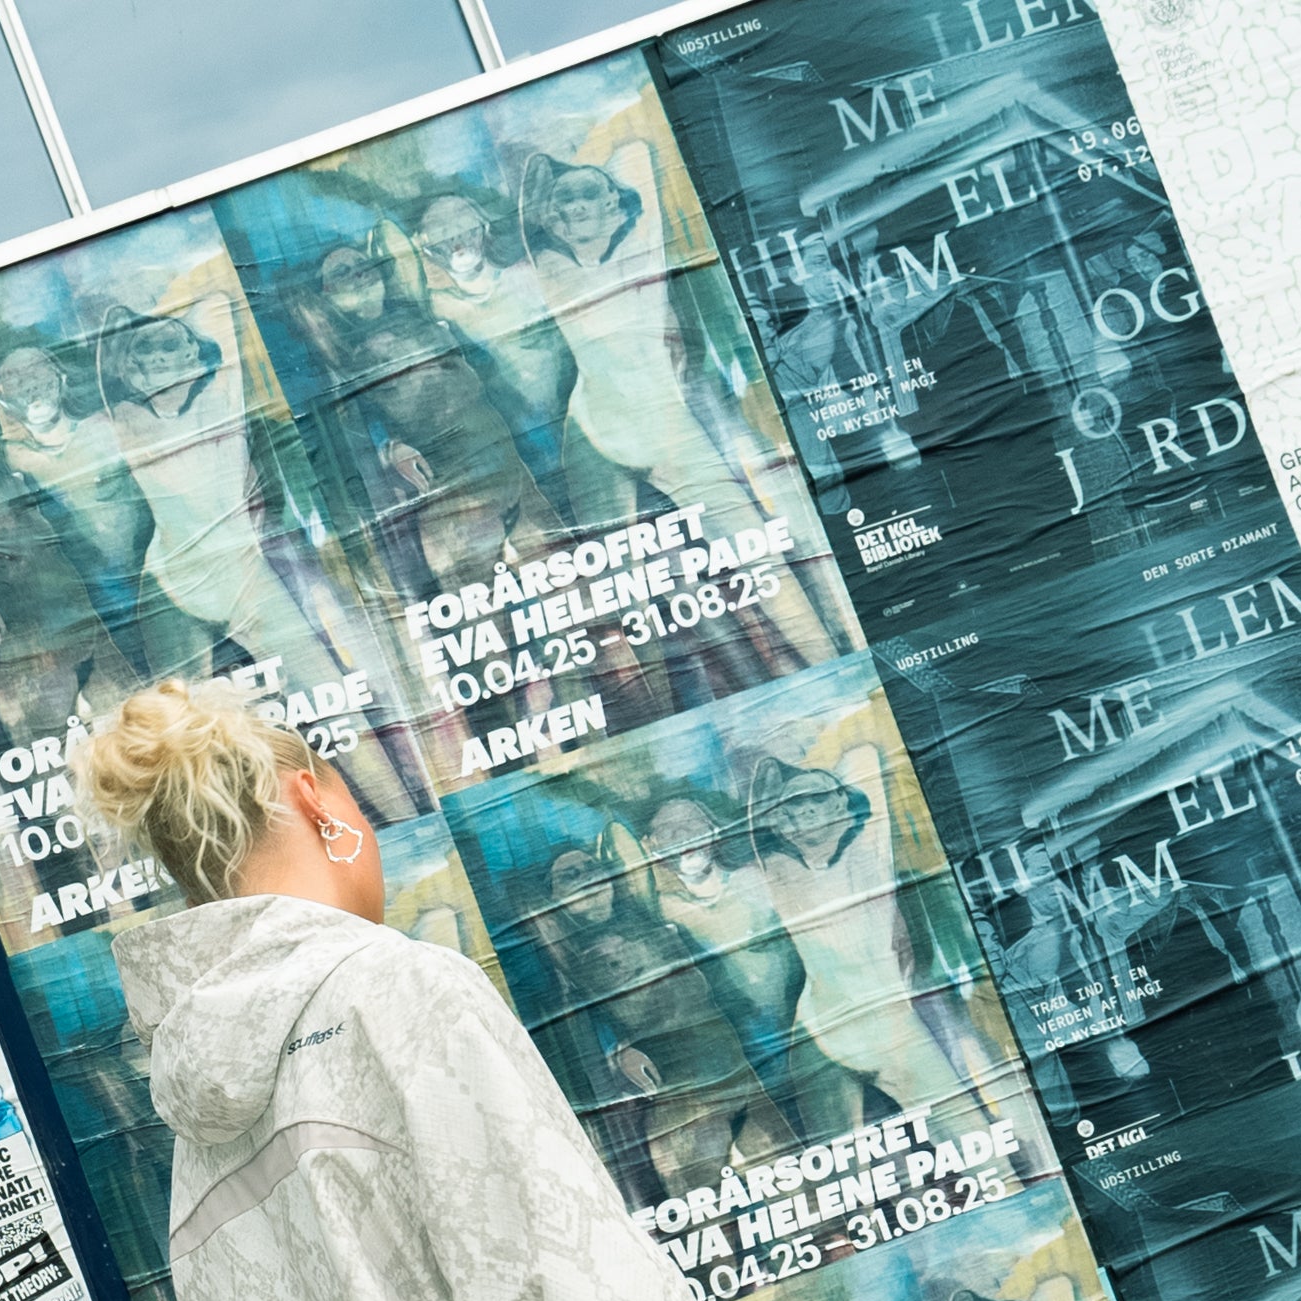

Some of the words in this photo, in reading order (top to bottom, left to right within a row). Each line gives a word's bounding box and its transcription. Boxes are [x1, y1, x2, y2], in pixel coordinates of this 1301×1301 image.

[678, 18, 762, 56] UDSTILLING
[804, 383, 841, 405] TRÆD
[850, 372, 879, 391] IND
[885, 366, 896, 379] I
[903, 357, 923, 373] EN
[809, 395, 867, 424] VERDEN
[874, 387, 893, 403] AF
[900, 371, 938, 394] MAGI
[854, 525, 887, 551] DET
[889, 517, 925, 539] KGL.
[860, 526, 943, 566] BIBLIOTEK
[1142, 564, 1169, 582] DEN
[1174, 547, 1216, 570] SORTE
[1221, 523, 1278, 553] DIAMANT
[404, 503, 706, 639] FORÅRSOFRET
[419, 620, 507, 679] EVA
[511, 560, 676, 647] HELENE
[680, 516, 795, 583] PADE
[432, 629, 597, 715] 10.04.25
[626, 563, 782, 645] 31.08.25
[896, 632, 979, 671] UDSTILLING
[460, 693, 607, 779] ARKEN
[737, 1160, 900, 1250] HELENE
[905, 1118, 1020, 1189] PADE
[847, 1166, 1007, 1254] 31.08.25
